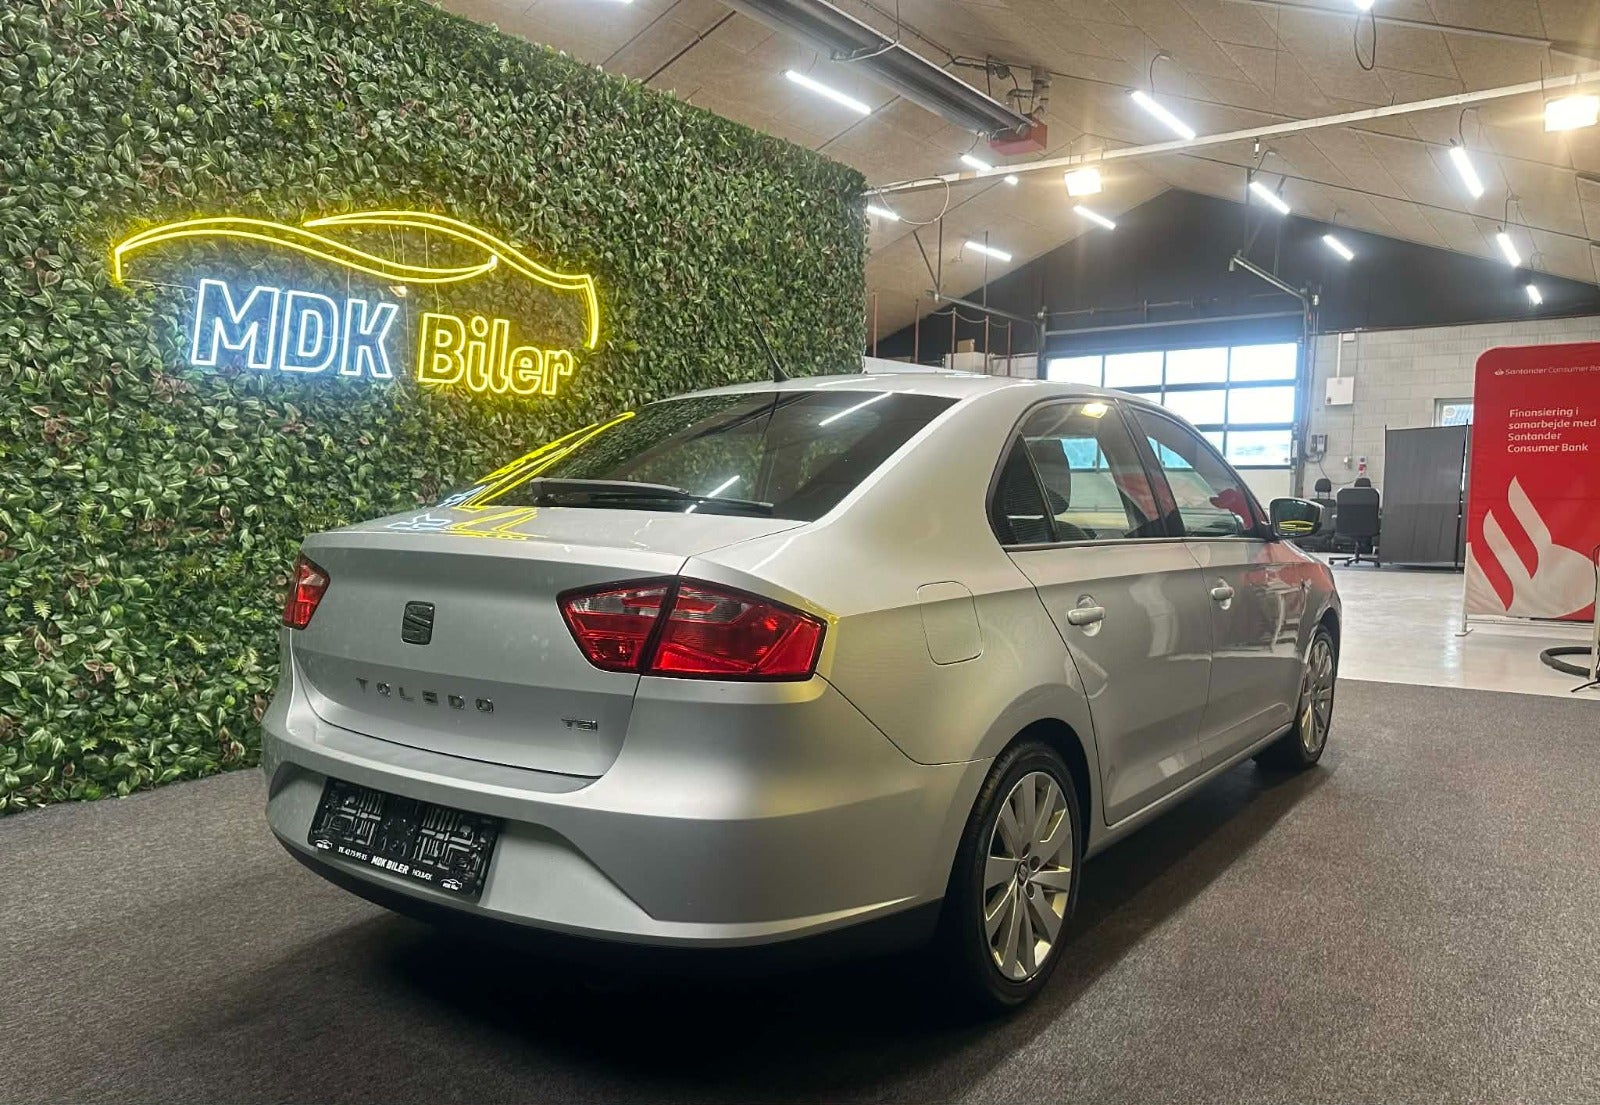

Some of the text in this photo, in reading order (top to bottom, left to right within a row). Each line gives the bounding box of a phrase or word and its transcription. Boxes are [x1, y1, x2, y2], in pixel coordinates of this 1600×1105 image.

[190, 278, 575, 397] MDK Biler
[1505, 367, 1547, 376] Santander
[1548, 366, 1588, 374] Consumer
[1509, 407, 1579, 418] Finansiering i
[1508, 418, 1597, 430] samarbejde med
[1508, 431, 1562, 441] Santander
[1507, 443, 1589, 453] Consumer Bank
[355, 676, 495, 713] TOLEDO
[370, 855, 388, 868] MDK
[386, 859, 410, 875] BILER
